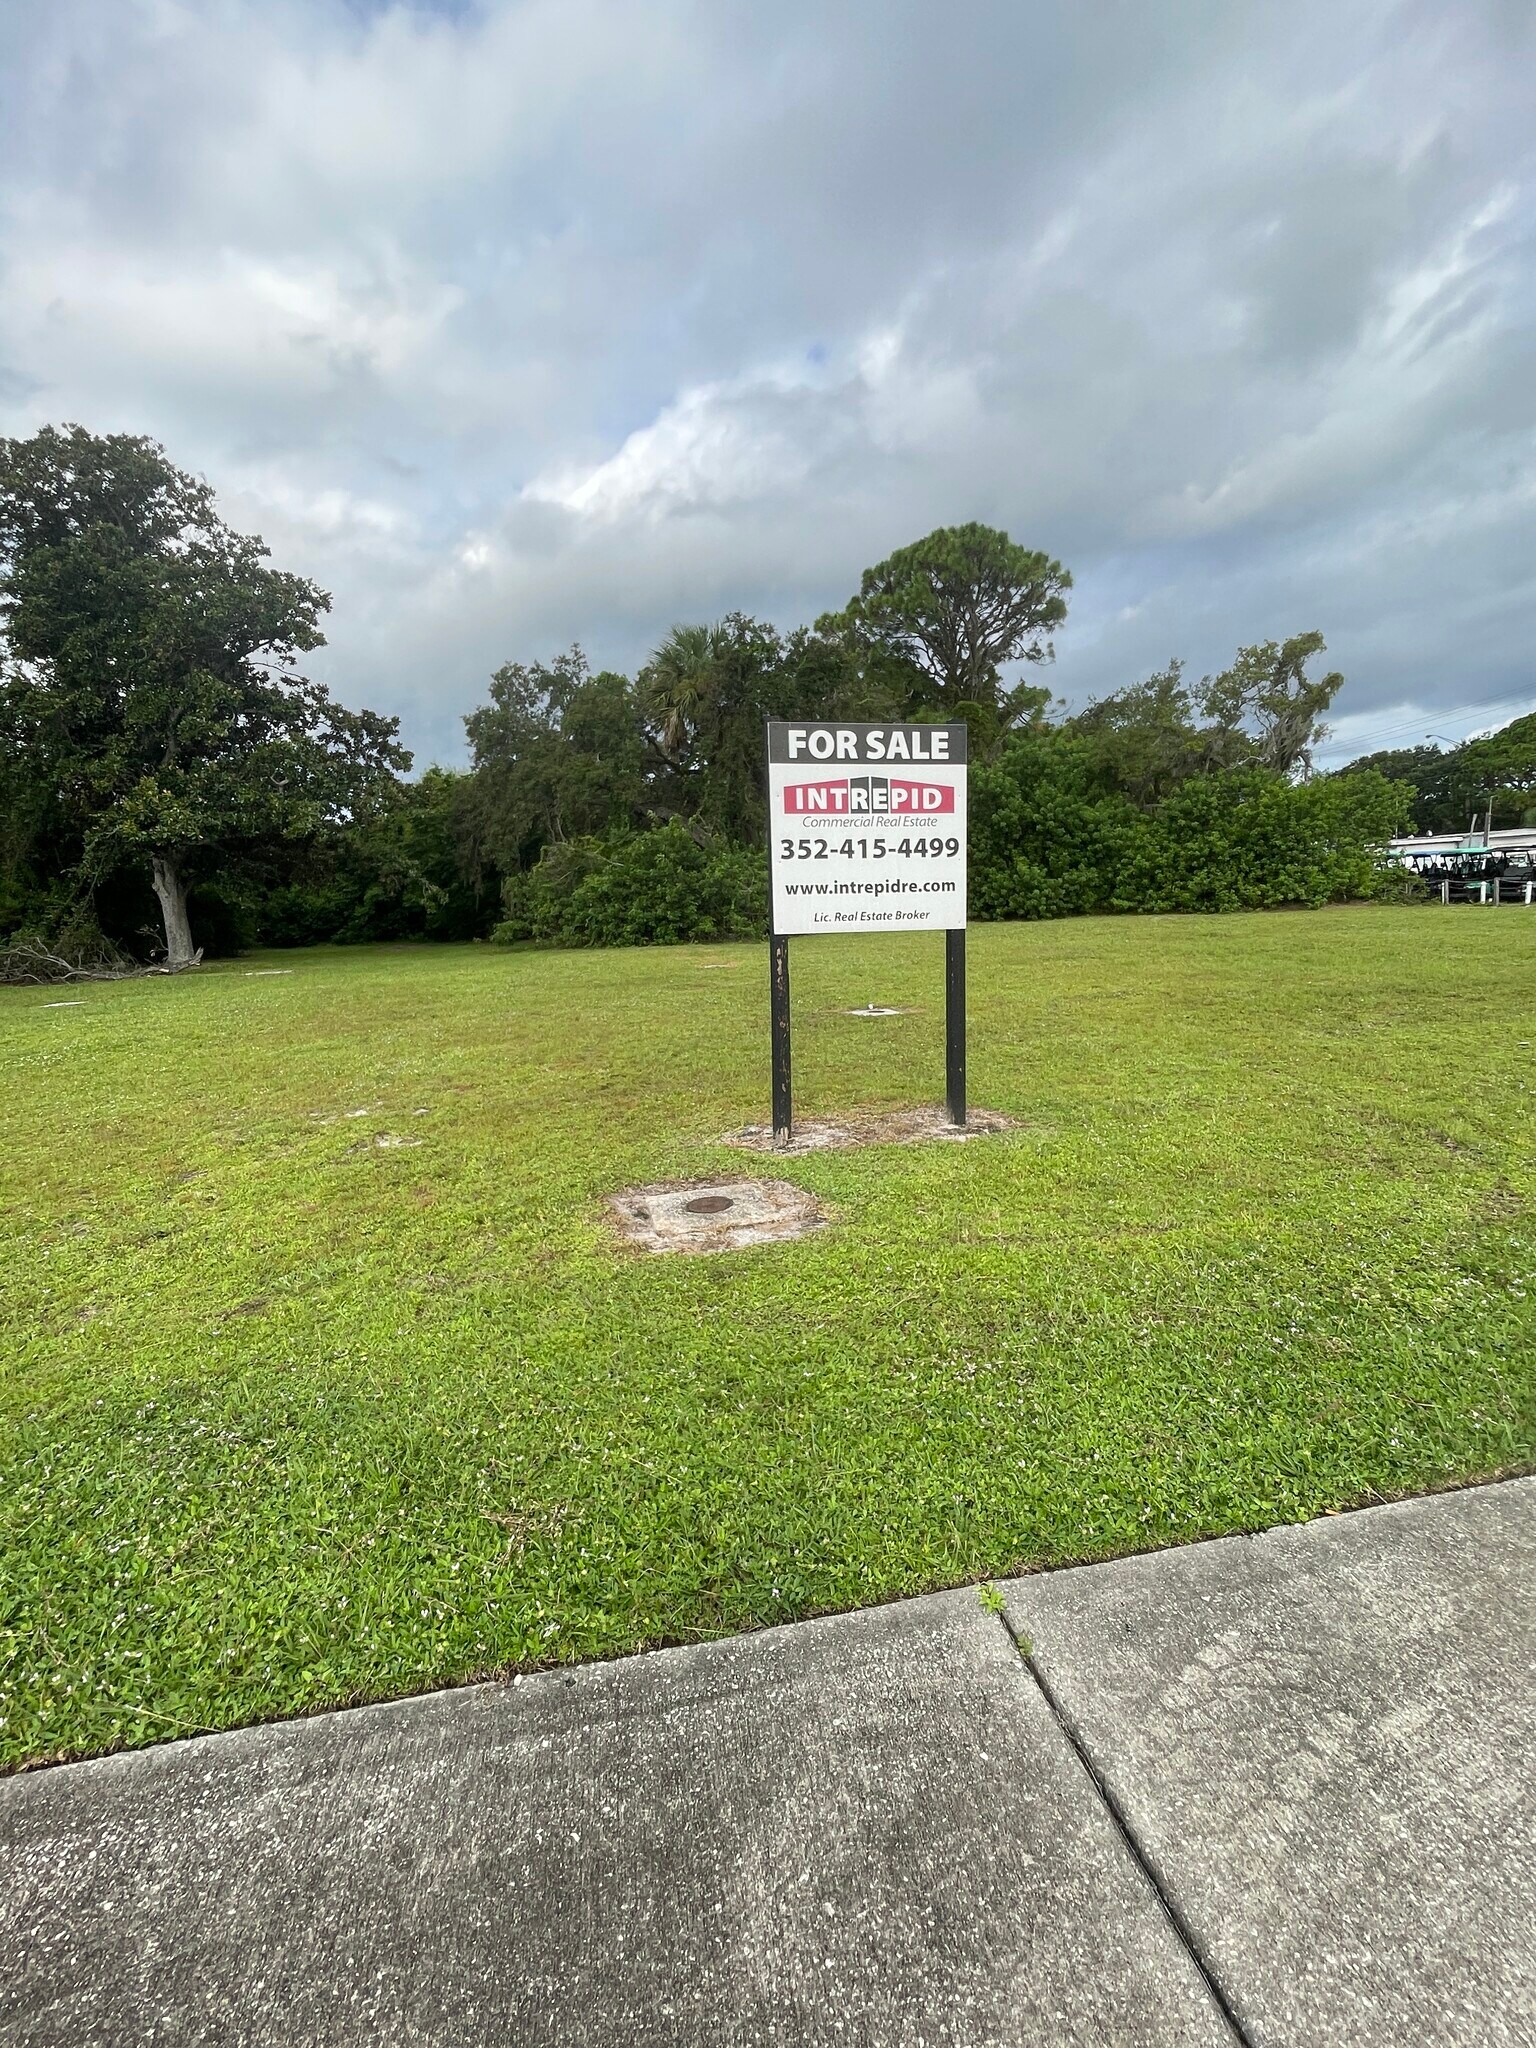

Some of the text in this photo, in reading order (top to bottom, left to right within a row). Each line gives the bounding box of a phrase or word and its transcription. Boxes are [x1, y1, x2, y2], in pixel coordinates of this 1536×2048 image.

[788, 730, 949, 760] FOR SALE
[795, 788, 942, 810] INTREPID
[802, 816, 938, 828] Commercial Real Estate
[780, 838, 960, 860] 352-415-4499
[785, 879, 956, 897] www.intrepidre.com
[814, 910, 930, 922] Lic. Real Estate Broker
